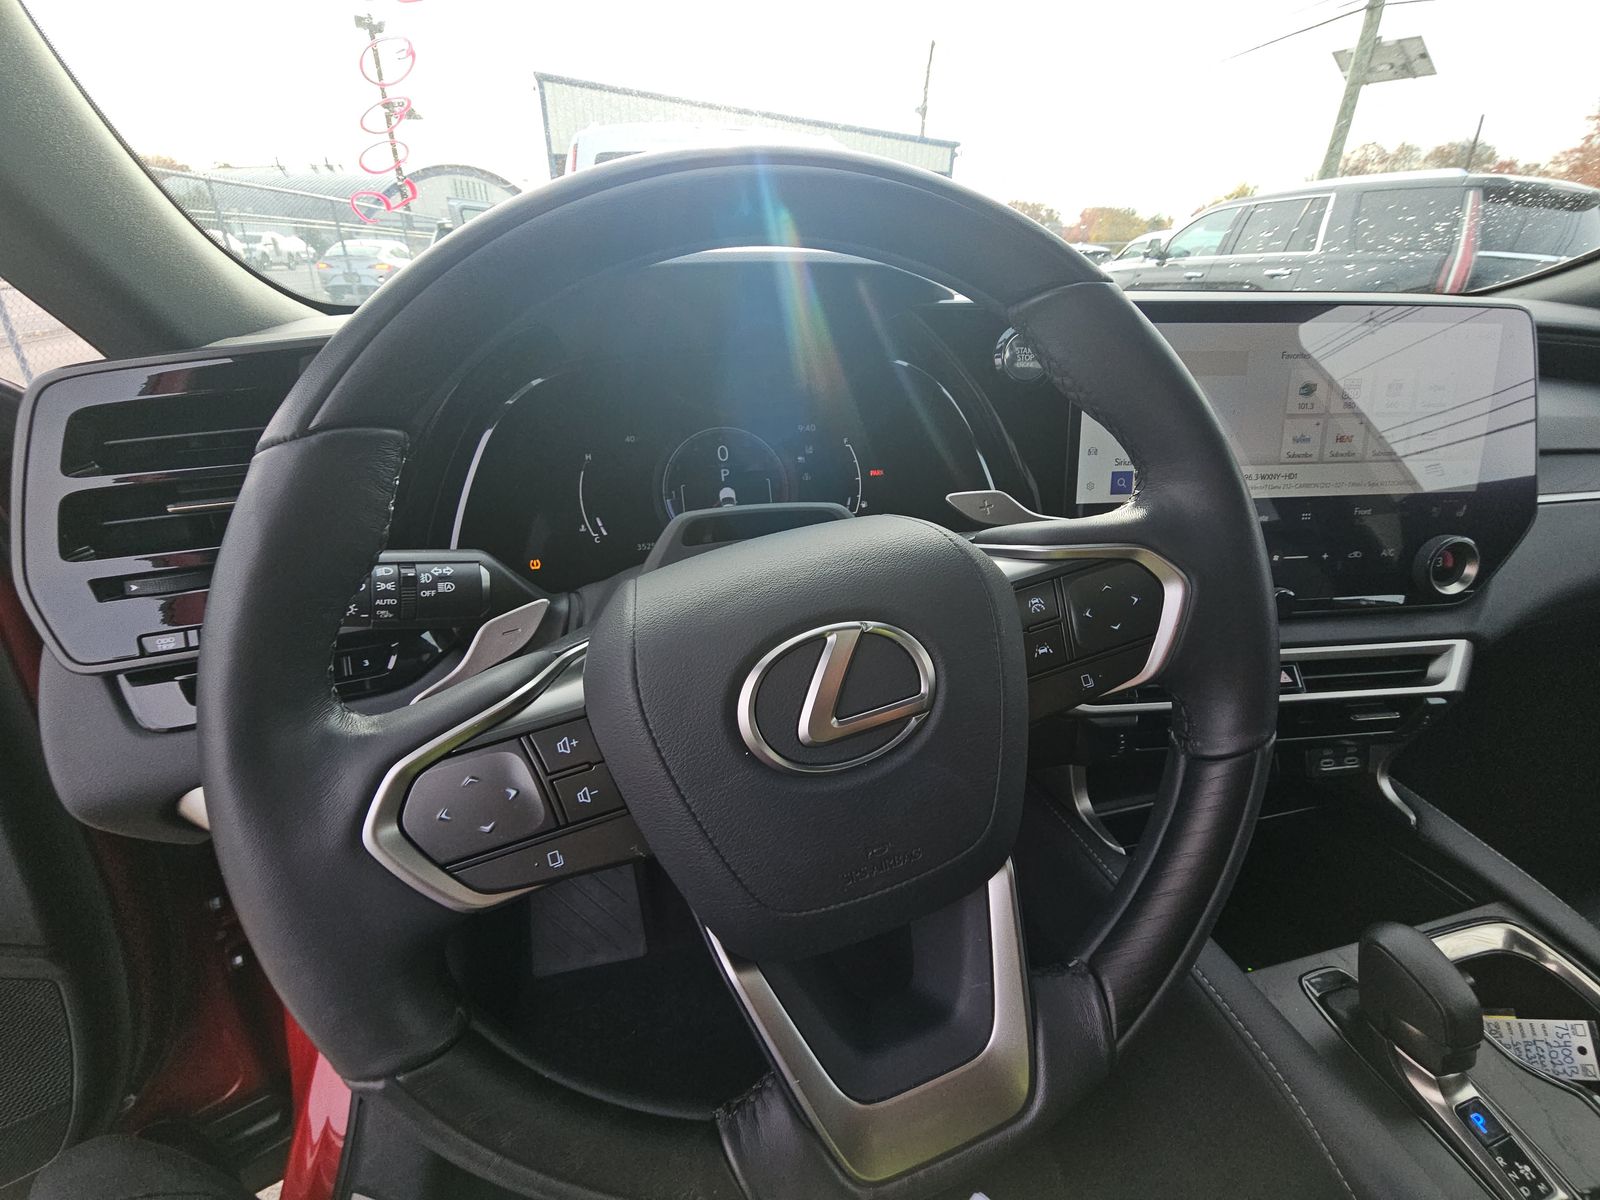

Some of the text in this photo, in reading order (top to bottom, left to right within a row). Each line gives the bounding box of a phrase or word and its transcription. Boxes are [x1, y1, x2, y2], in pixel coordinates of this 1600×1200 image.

[1015, 346, 1032, 354] STAR
[1016, 354, 1035, 362] STOP
[1281, 351, 1312, 360] Favorites
[1297, 402, 1315, 410] 101.3
[584, 453, 592, 461] H
[720, 468, 730, 482] P
[420, 589, 436, 598] OFF
[375, 598, 398, 606] AUTO
[1470, 1111, 1488, 1134] P
[1495, 1156, 1508, 1167] R
[1519, 1186, 1531, 1198] D
